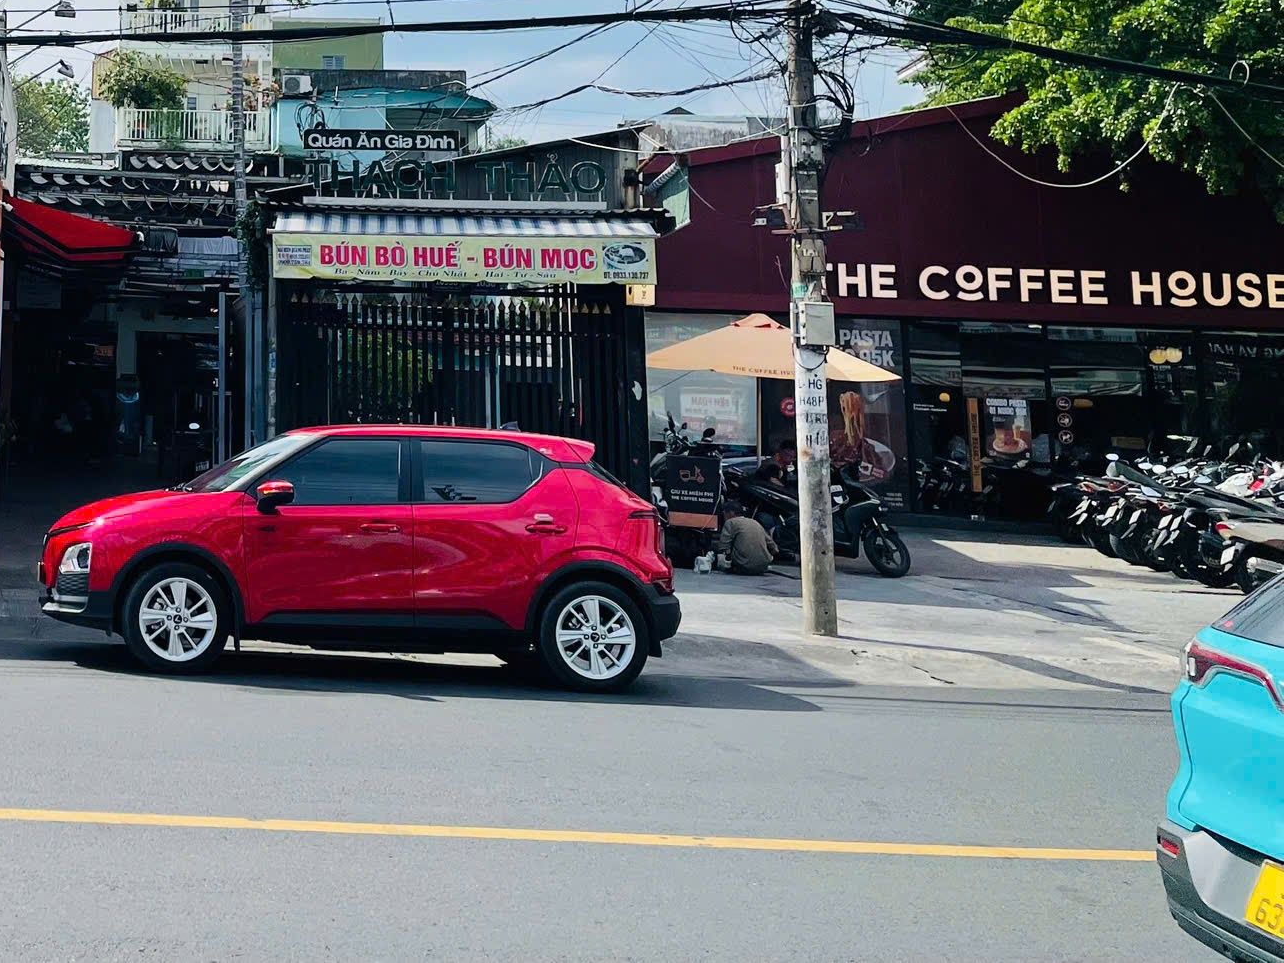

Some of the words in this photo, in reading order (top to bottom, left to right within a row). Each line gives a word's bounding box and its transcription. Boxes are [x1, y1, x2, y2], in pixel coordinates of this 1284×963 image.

[307, 133, 352, 148] Quán
[356, 131, 381, 148] Ăn
[385, 134, 413, 149] Gia
[415, 134, 455, 149] Đình
[319, 241, 369, 266] BÚN
[375, 241, 407, 267] BÒ
[413, 240, 463, 268] HUẾ
[483, 244, 533, 269] BÚN
[540, 248, 596, 274] MỌC
[919, 265, 1108, 304] COFFEE
[1131, 271, 1284, 308] HOUSE
[839, 329, 894, 348] PASTA
[1254, 895, 1284, 935] 63
